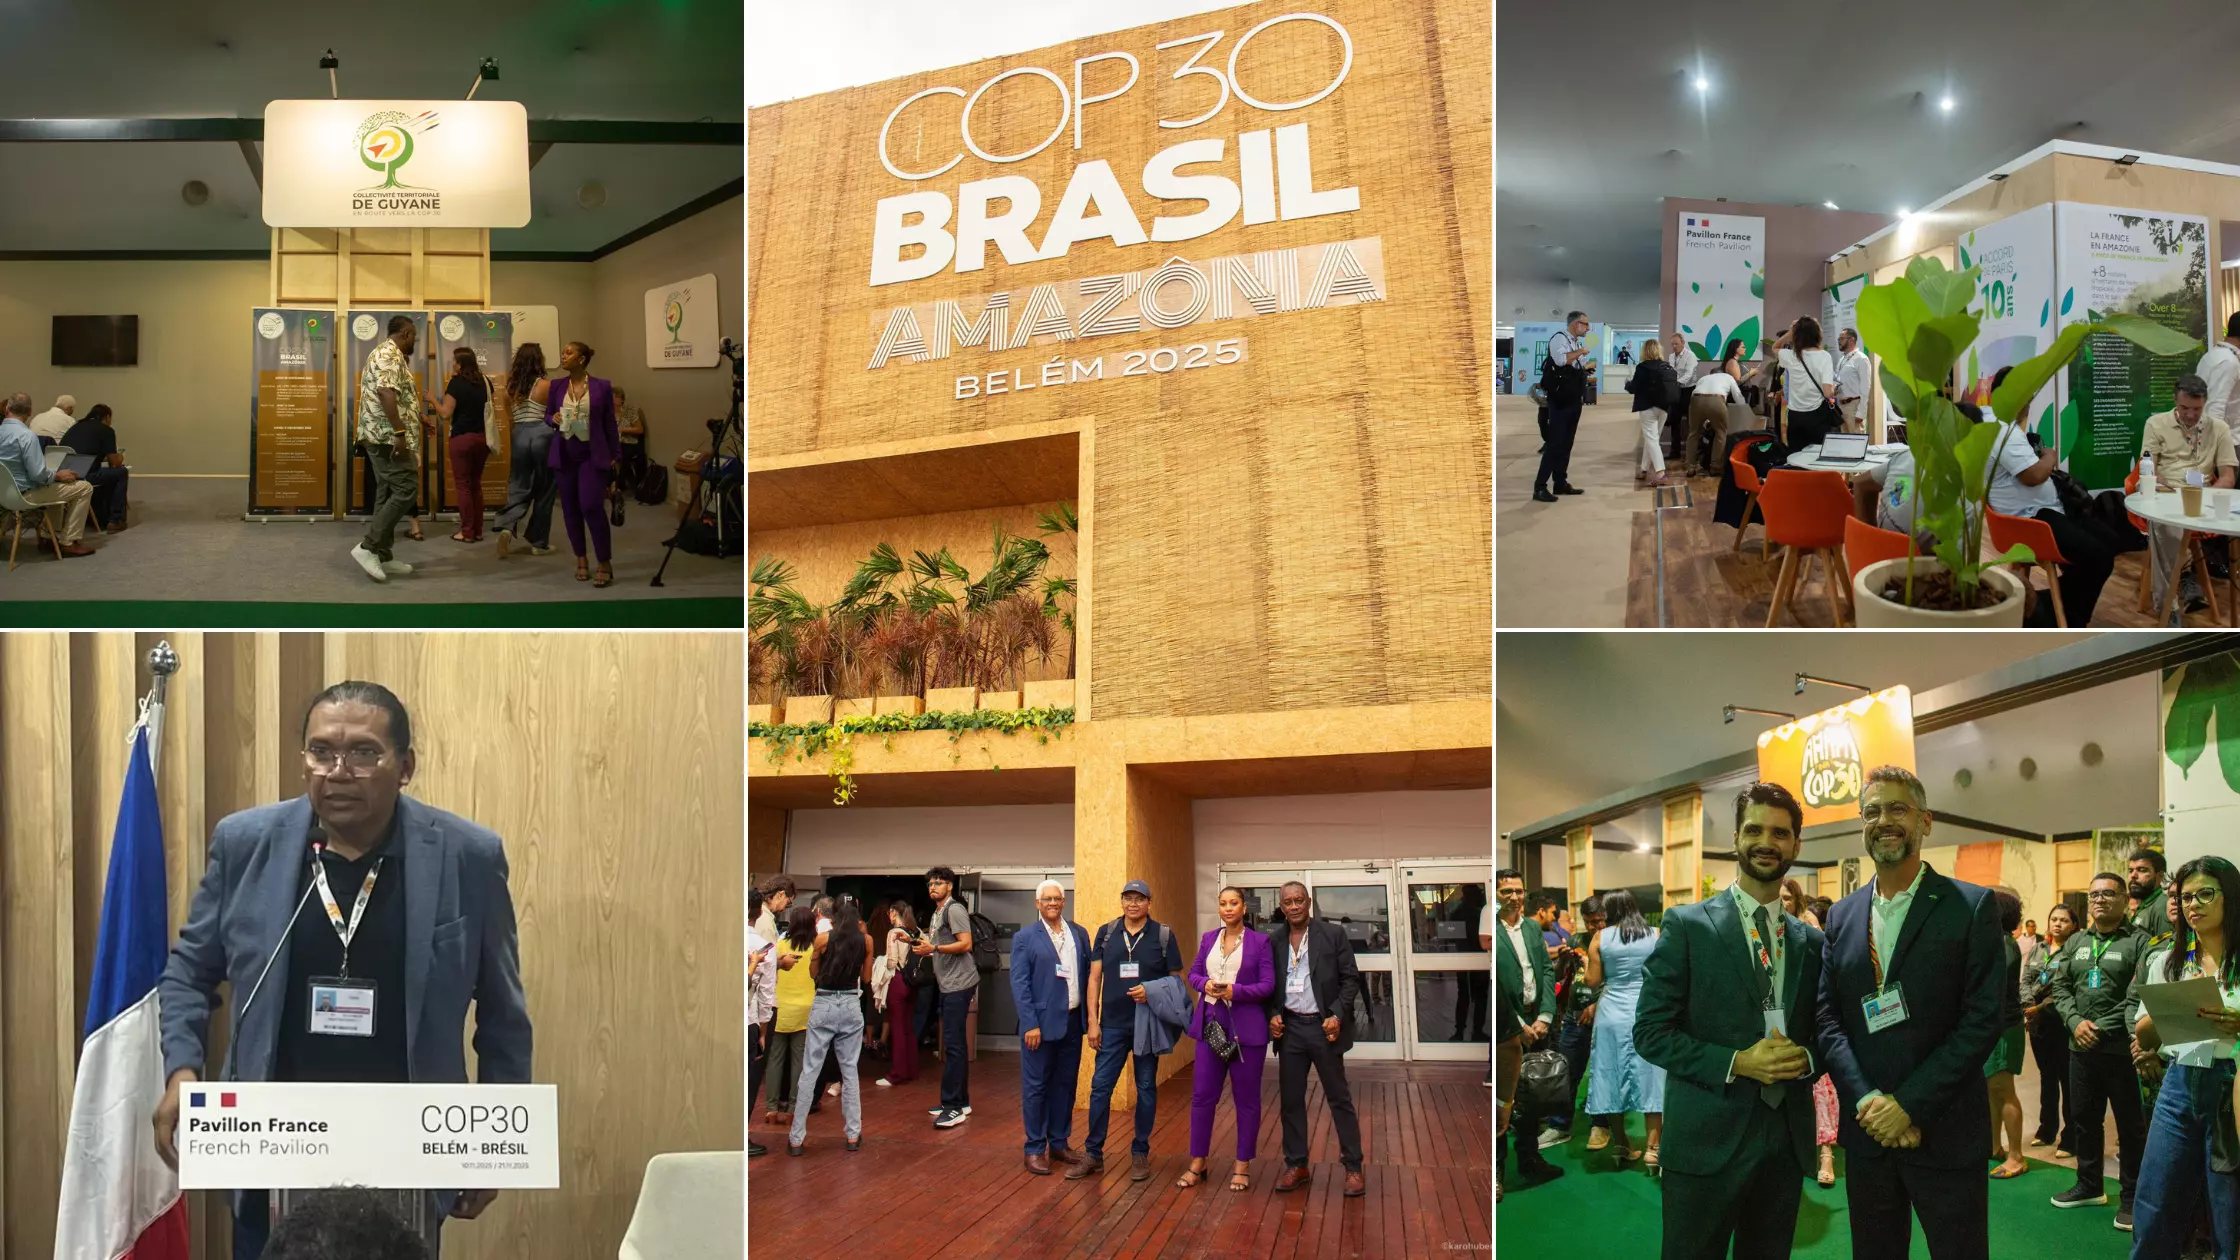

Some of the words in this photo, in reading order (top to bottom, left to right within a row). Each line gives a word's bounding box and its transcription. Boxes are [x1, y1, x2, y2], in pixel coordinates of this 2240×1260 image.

[352, 199, 373, 210] DE
[378, 199, 441, 210] GUYANE
[869, 121, 1361, 287] BRASIL
[1686, 230, 1721, 239] Pavillon
[1723, 232, 1752, 241] France
[2090, 231, 2101, 240] LA
[2101, 232, 2130, 243] FRANCE
[1686, 240, 1715, 249] French
[1719, 241, 1752, 251] Pavilion
[2090, 242, 2101, 250] EN
[2102, 243, 2141, 253] AMAZONIE
[1983, 245, 2014, 264] ACCORD
[1992, 260, 2014, 276] PARIS
[2091, 265, 2107, 278] +8
[867, 241, 1382, 370] AMAZÔNIA
[1981, 280, 2005, 320] 10
[2006, 285, 2014, 317] ans
[2149, 302, 2169, 312] Over
[2170, 303, 2176, 313] 8
[672, 348, 693, 357] GUYANE
[954, 356, 1104, 401] BELÉM
[1122, 339, 1242, 377] 2025
[189, 1117, 262, 1133] Pavillon
[268, 1117, 329, 1133] France
[421, 1104, 529, 1134] COP30
[189, 1139, 250, 1155] French
[259, 1139, 329, 1155] Pavilion
[422, 1139, 468, 1155] BELÉM
[481, 1139, 529, 1155] BRÉSIL
